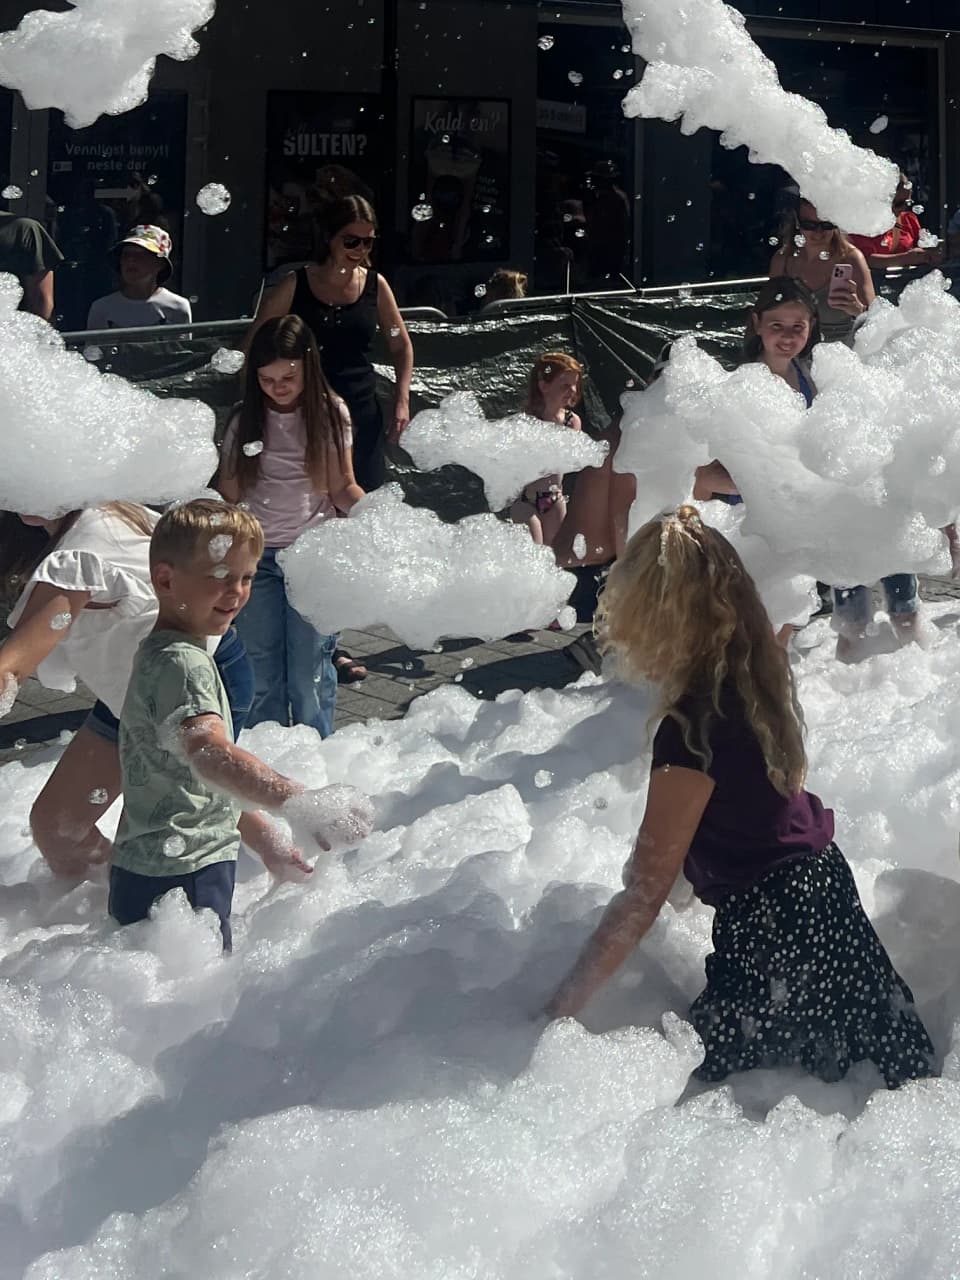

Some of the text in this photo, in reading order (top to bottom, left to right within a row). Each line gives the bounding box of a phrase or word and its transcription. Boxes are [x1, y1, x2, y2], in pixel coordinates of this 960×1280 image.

[424, 111, 501, 133] Kald en?
[65, 143, 169, 158] Vennligst benytt
[283, 132, 368, 156] SULTEN?
[87, 159, 123, 170] neste
